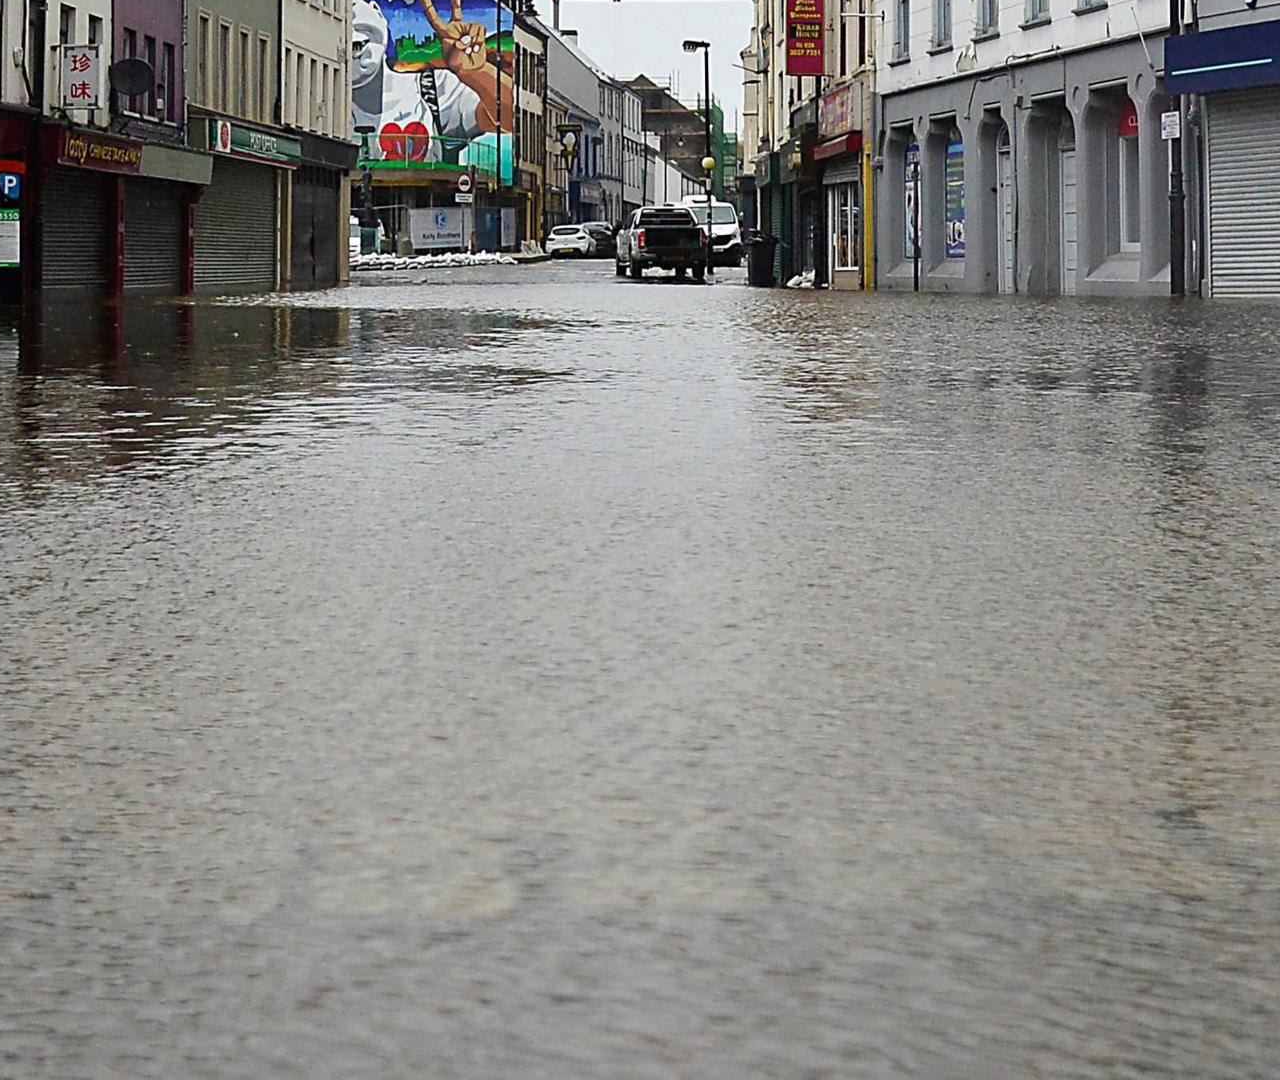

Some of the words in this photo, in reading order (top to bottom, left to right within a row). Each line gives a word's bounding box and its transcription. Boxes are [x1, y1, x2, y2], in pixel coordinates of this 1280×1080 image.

[796, 23, 820, 31] KEBAB
[70, 53, 92, 100] 珍味
[249, 131, 261, 151] POST
[4, 175, 17, 195] P
